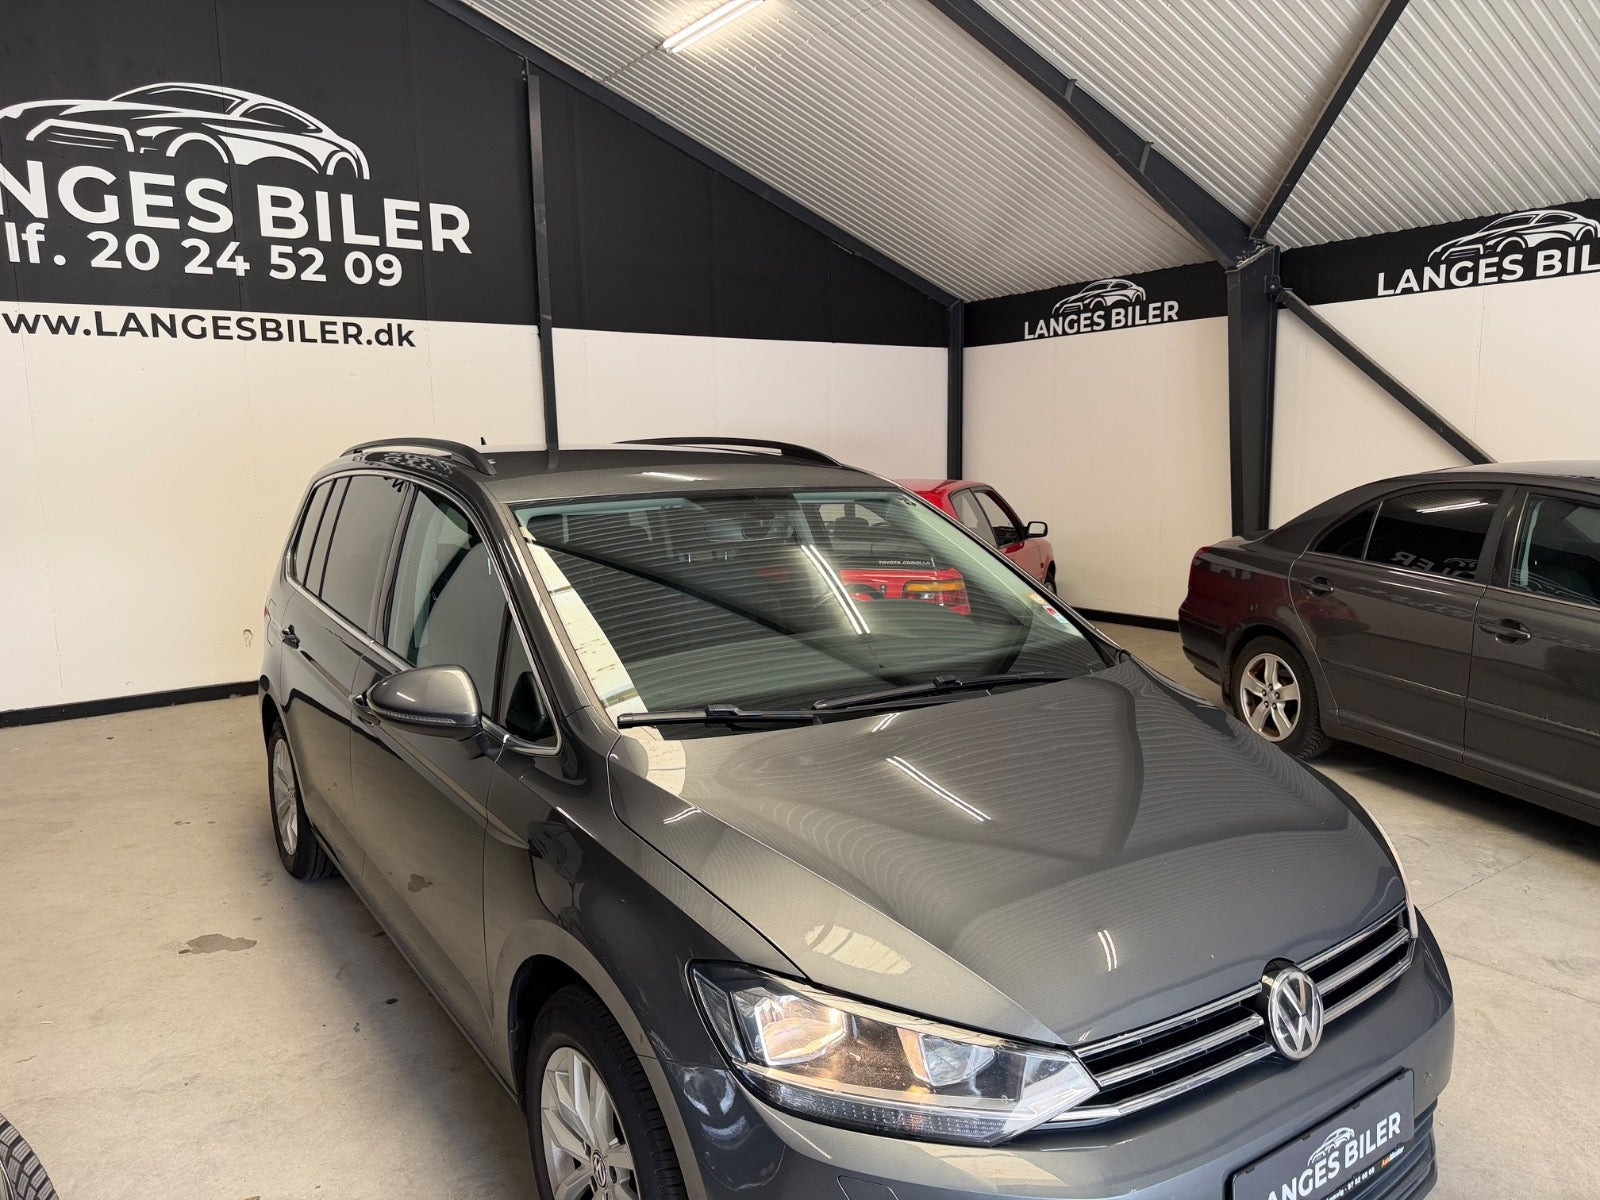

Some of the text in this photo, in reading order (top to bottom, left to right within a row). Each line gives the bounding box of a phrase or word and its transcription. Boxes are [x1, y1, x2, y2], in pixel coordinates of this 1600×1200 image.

[0, 159, 472, 254] NGES BILER
[5, 221, 403, 287] lf. 20 24 52 09
[1377, 244, 1600, 296] LANGES BIL
[1024, 300, 1179, 340] LANGES BILER
[1344, 1111, 1401, 1169] BILER
